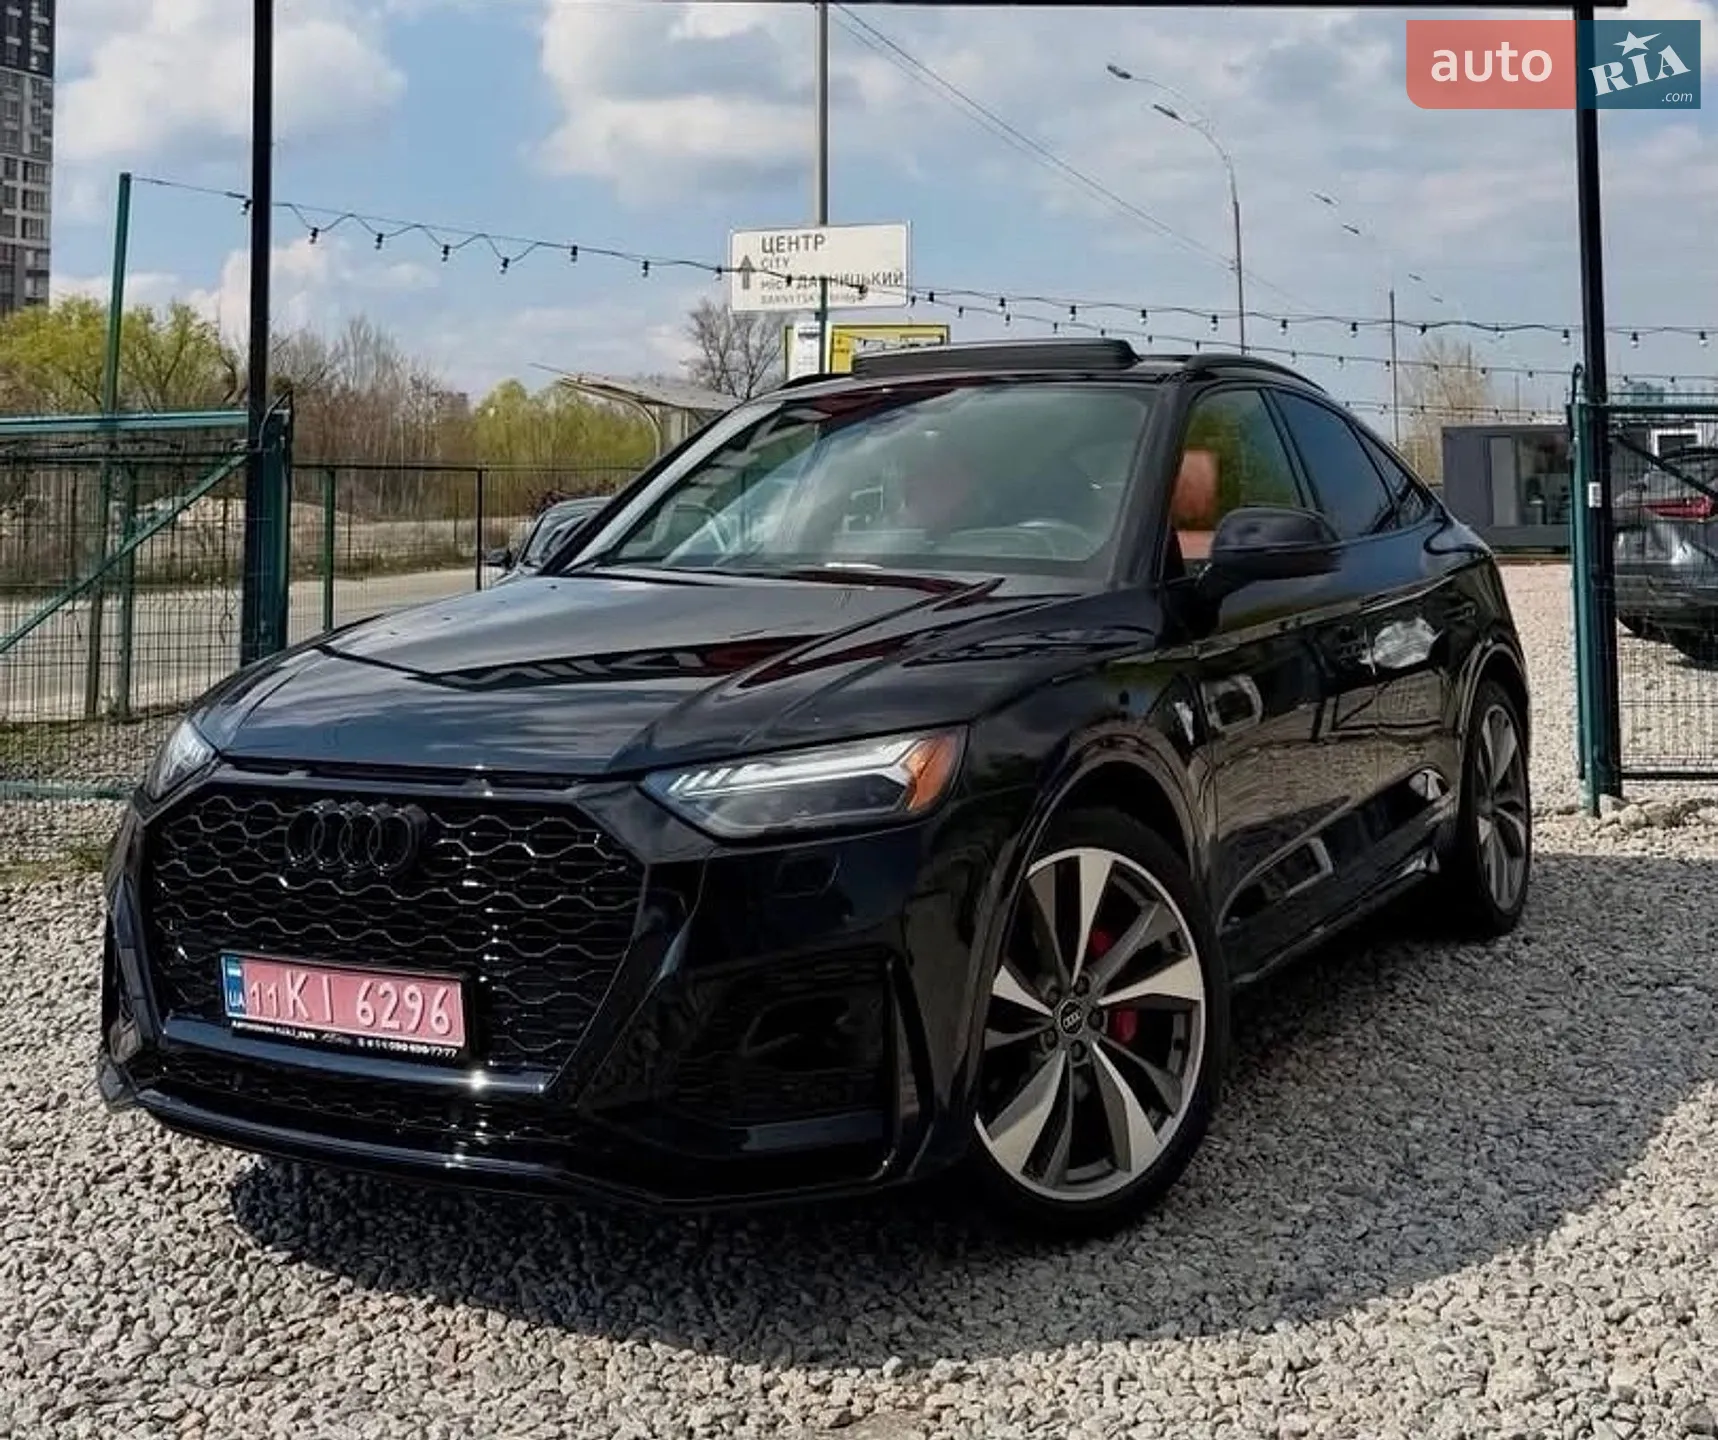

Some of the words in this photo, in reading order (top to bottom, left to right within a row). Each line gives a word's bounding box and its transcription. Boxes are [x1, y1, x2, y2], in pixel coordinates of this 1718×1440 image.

[760, 234, 826, 254] ЦЕНТР
[761, 257, 790, 270] CITY
[796, 268, 903, 290] ДАНИЦЬКИЙ
[229, 990, 245, 1006] UA
[356, 980, 452, 1036] 6296
